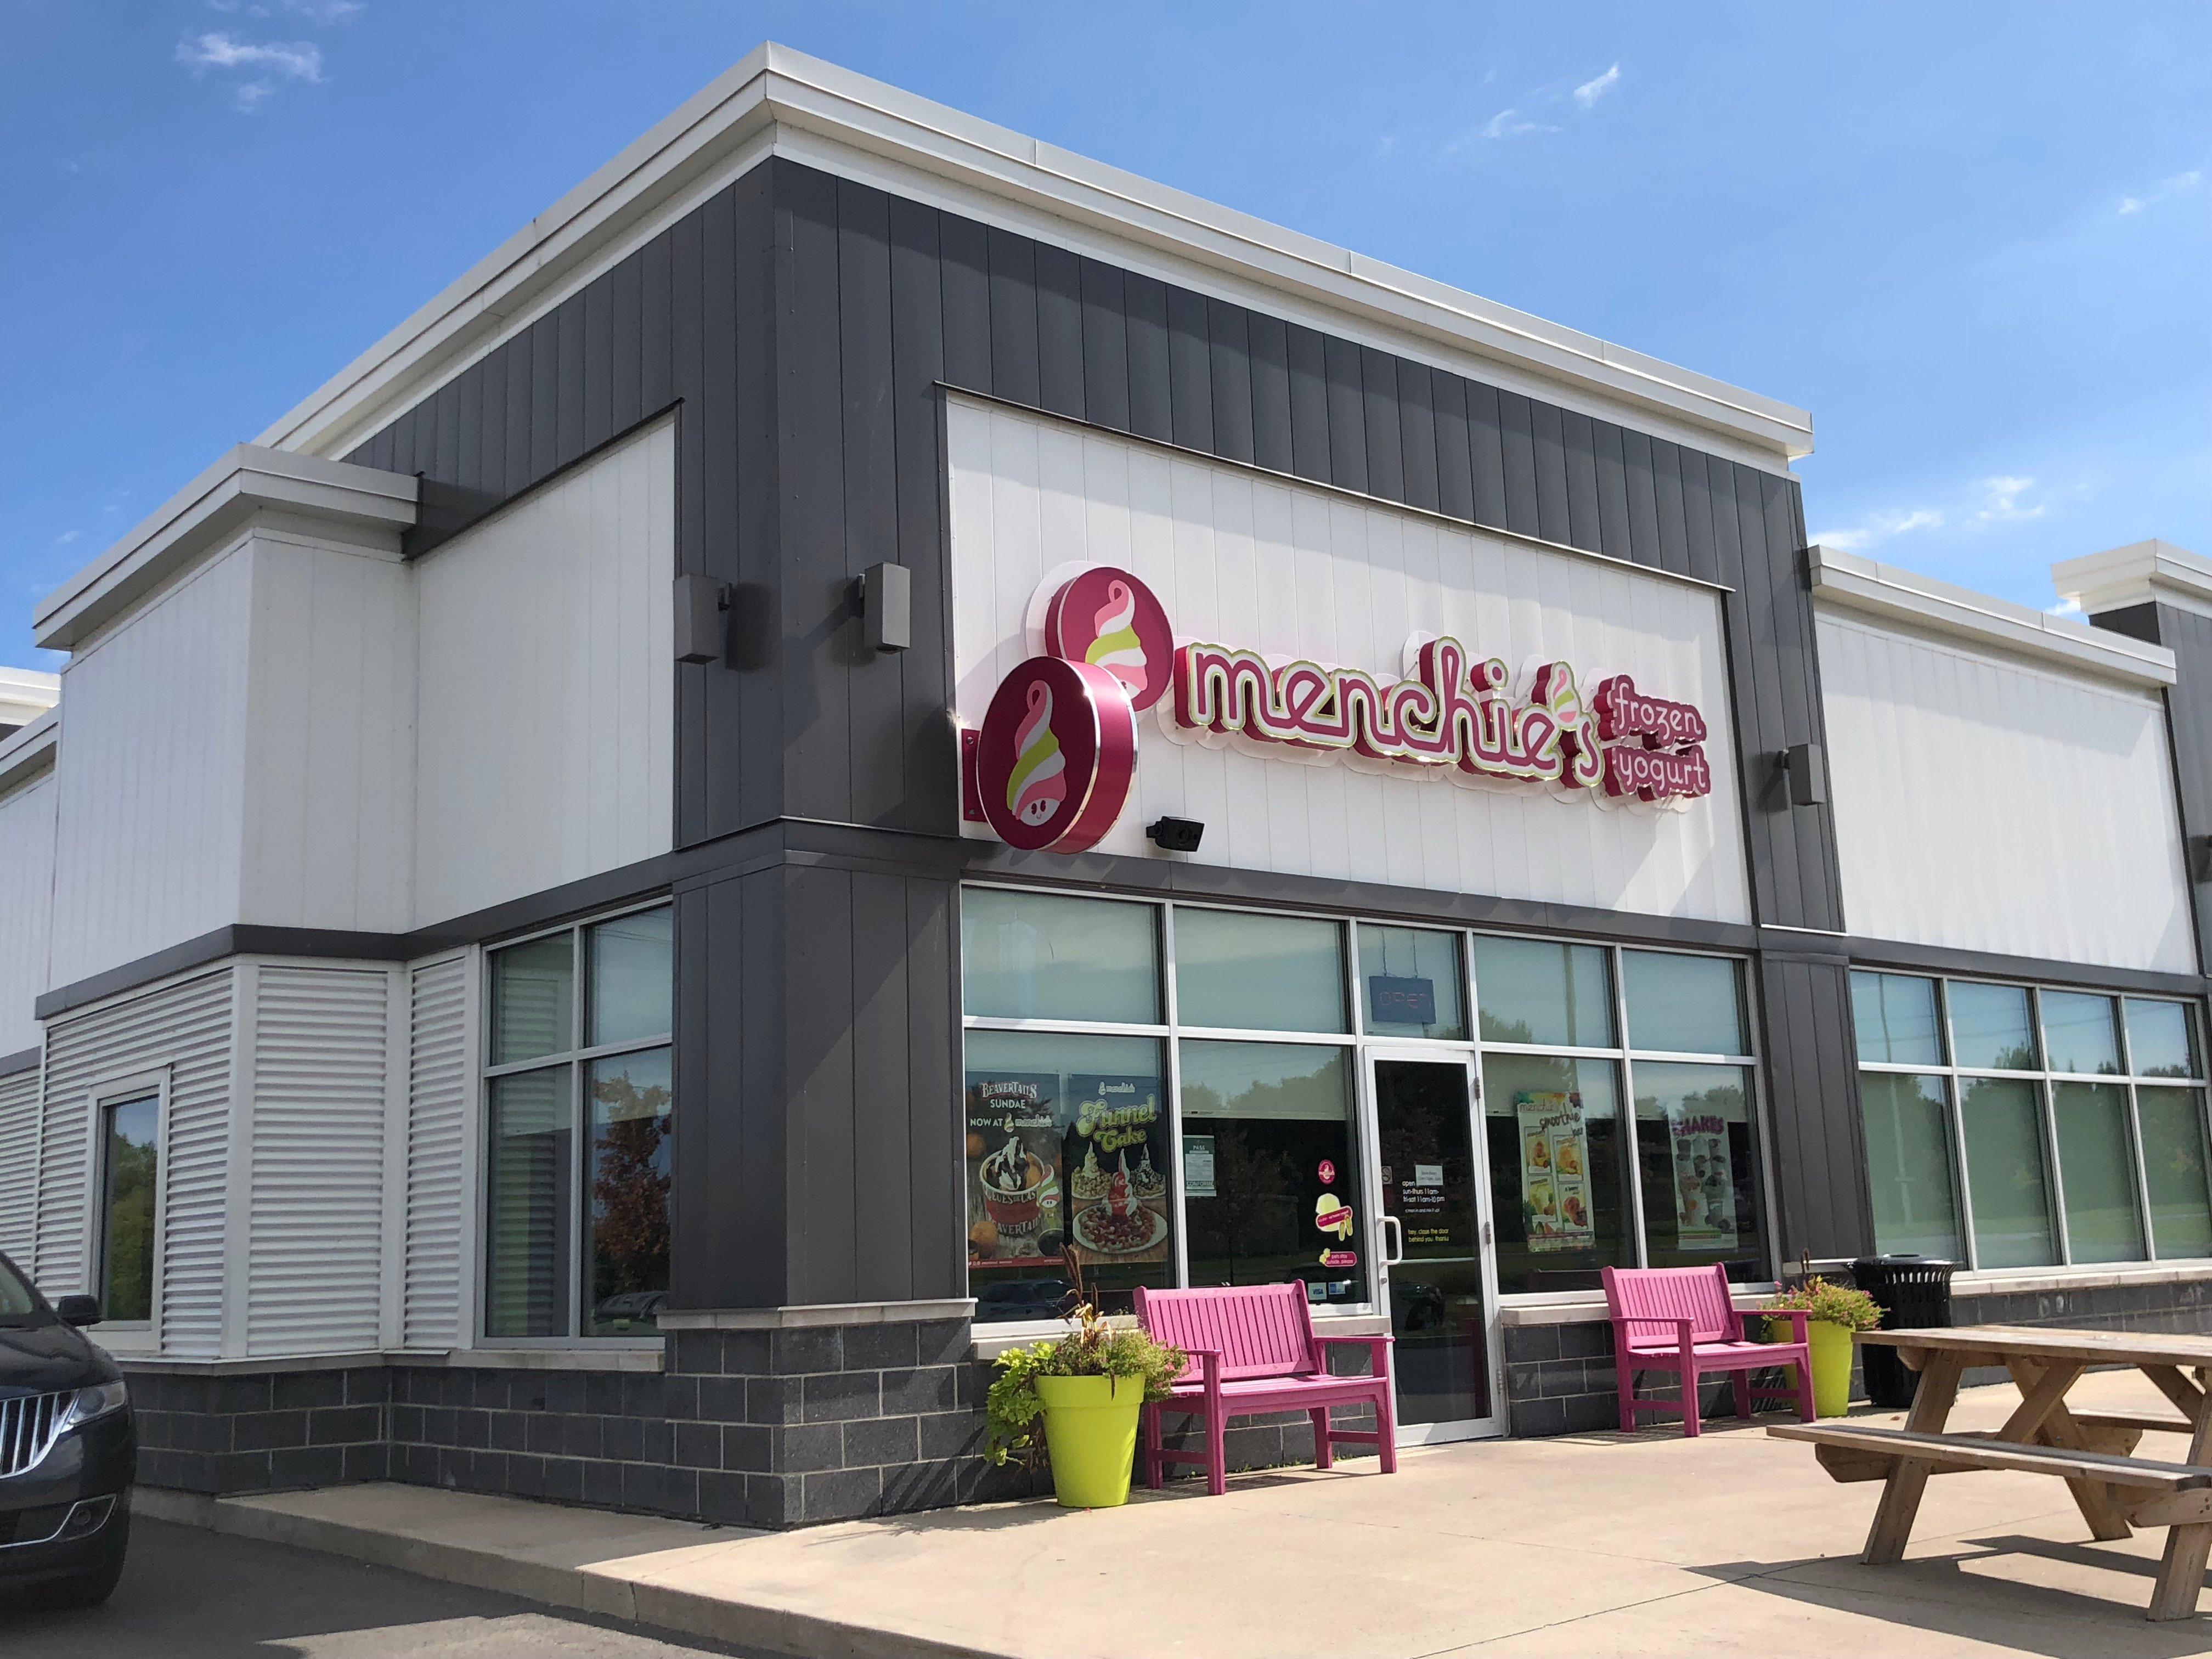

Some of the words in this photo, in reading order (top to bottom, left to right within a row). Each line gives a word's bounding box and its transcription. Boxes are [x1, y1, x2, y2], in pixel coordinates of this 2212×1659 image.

[1188, 635, 1604, 787] menchie's
[1615, 682, 1702, 740] frozen
[1619, 752, 1706, 792] yogurt
[970, 1118, 991, 1127] NOW
[992, 1118, 1003, 1127] AT
[990, 1099, 1026, 1109] SUNDAE
[1076, 1093, 1156, 1137] Funnel
[1093, 1125, 1148, 1152] Cake
